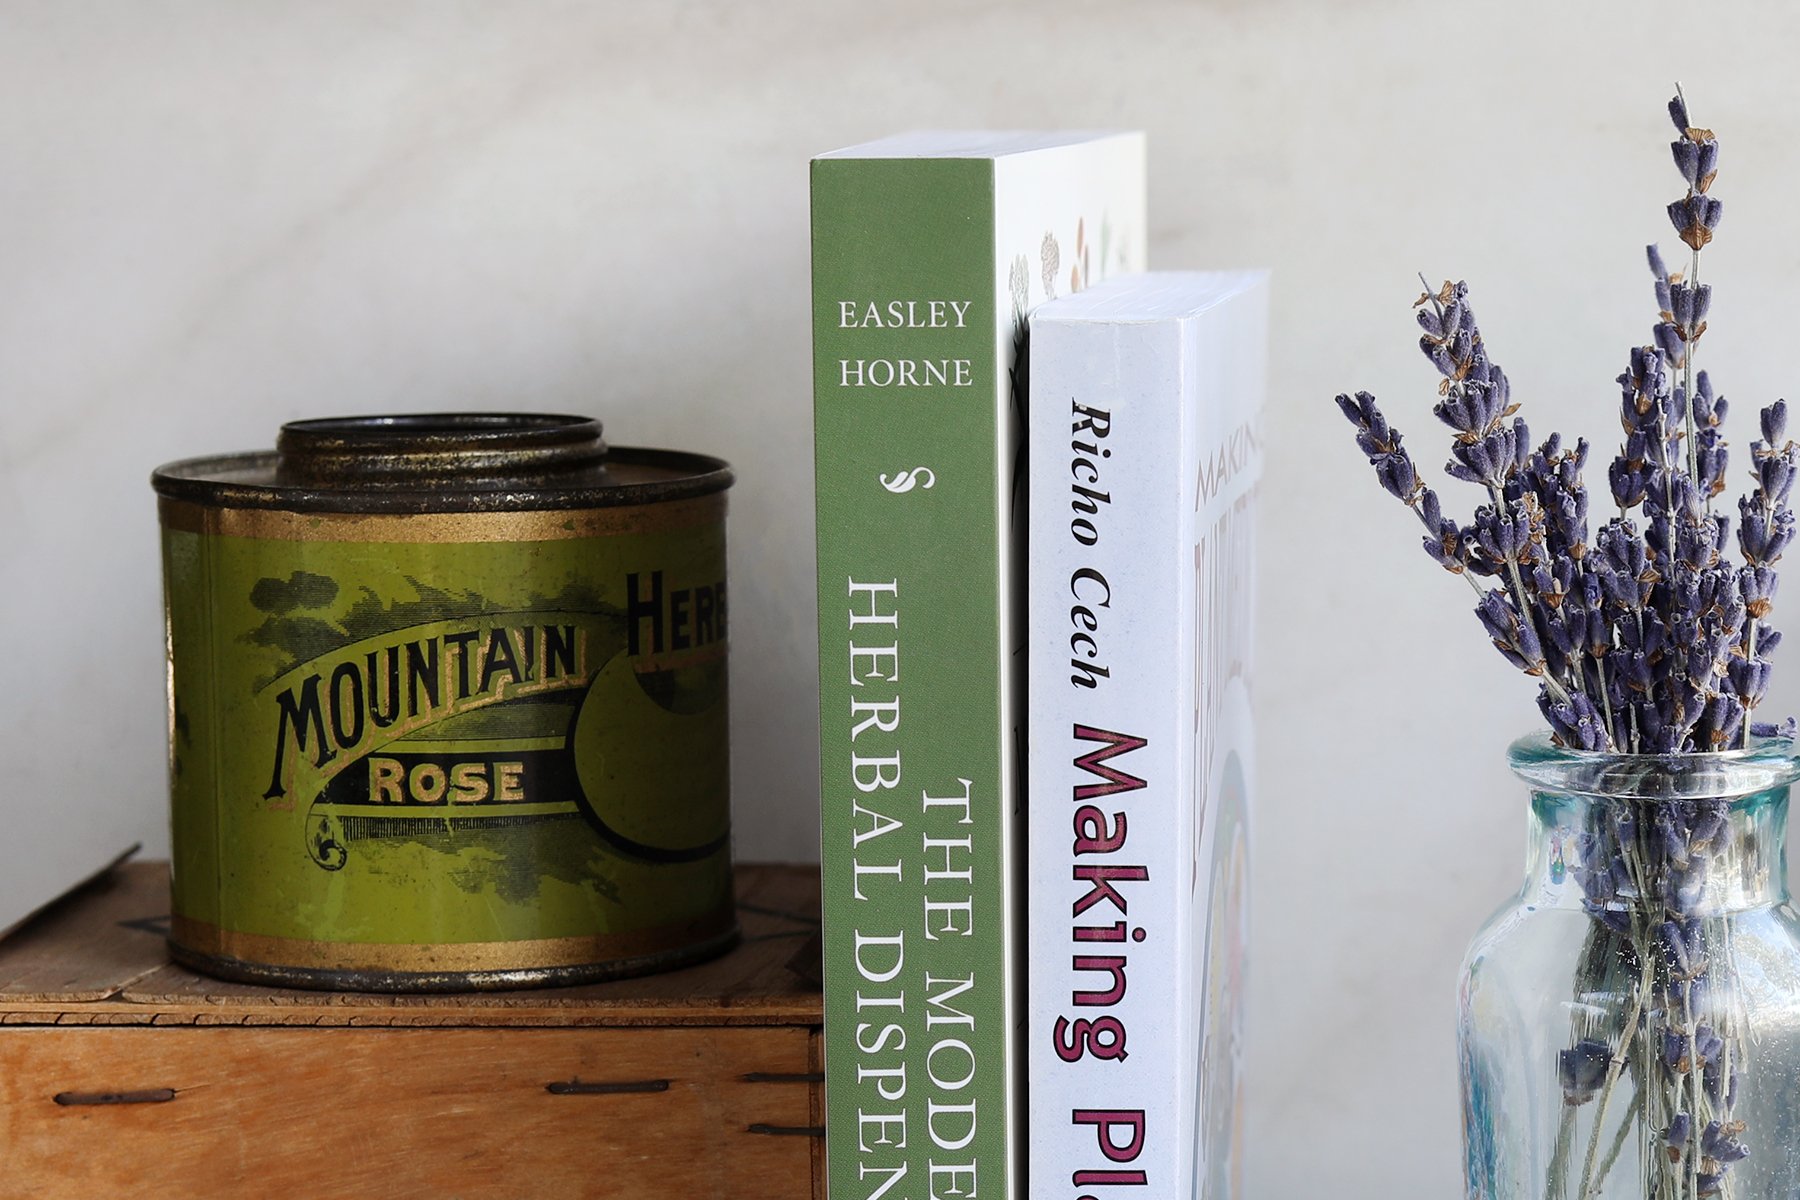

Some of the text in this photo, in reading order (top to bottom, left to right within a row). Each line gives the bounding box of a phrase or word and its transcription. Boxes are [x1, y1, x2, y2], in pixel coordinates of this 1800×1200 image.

[838, 300, 972, 329] EASLEY
[838, 359, 973, 387] HORNE
[1070, 396, 1112, 547] Richo
[1194, 421, 1256, 512] MAKIN
[1070, 567, 1111, 690] Cech
[262, 624, 584, 804] MOUNTAIN
[368, 756, 526, 803] ROSE
[848, 575, 903, 900] HERBAL
[922, 777, 974, 942] THE
[1053, 723, 1150, 1064] Making
